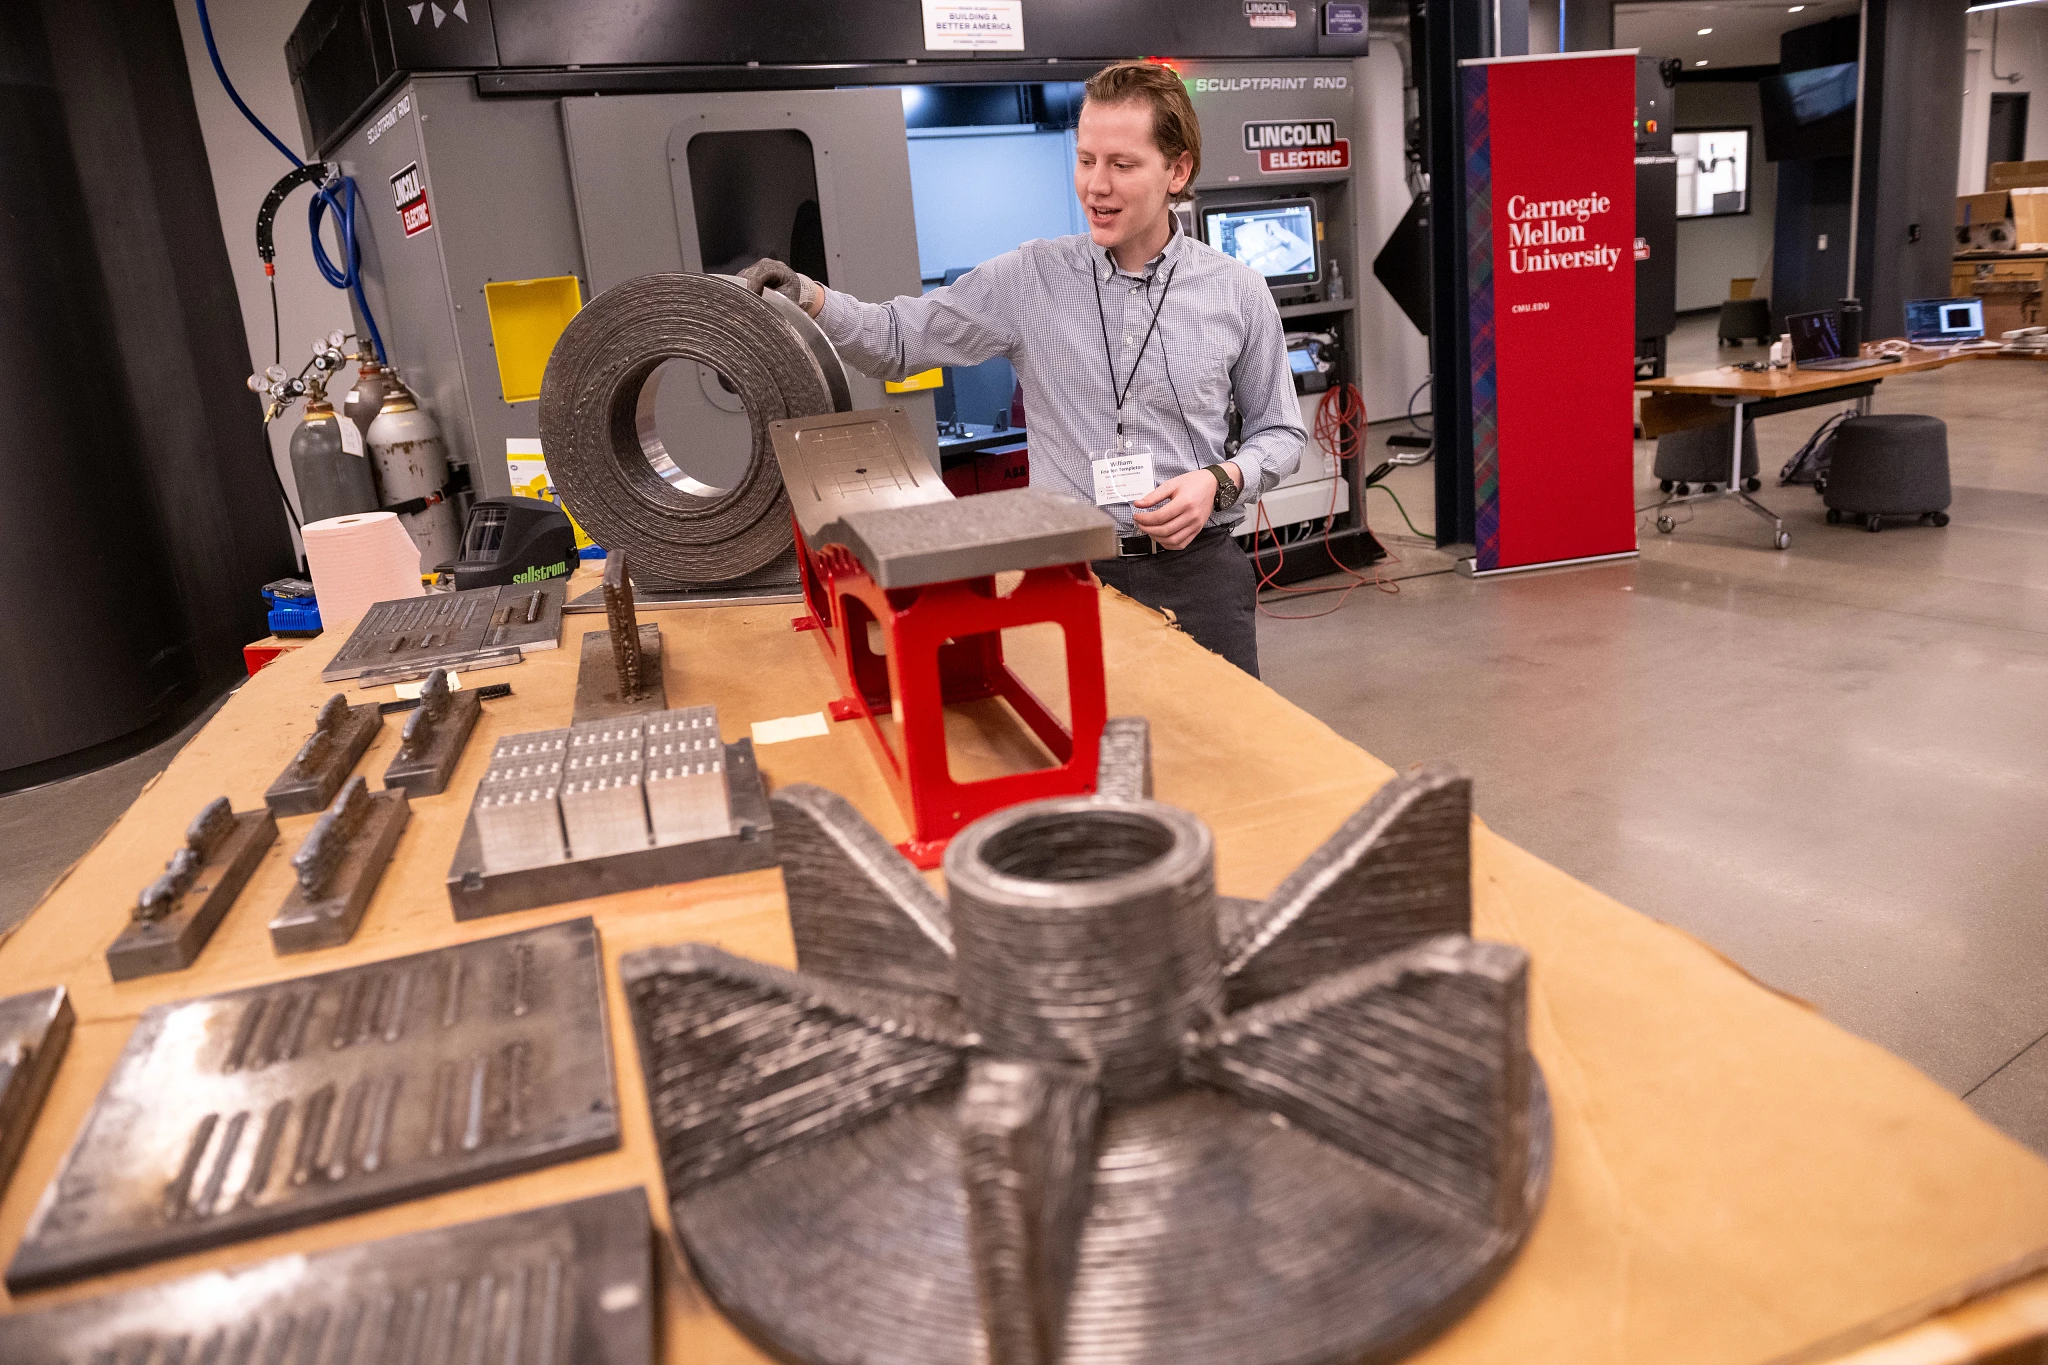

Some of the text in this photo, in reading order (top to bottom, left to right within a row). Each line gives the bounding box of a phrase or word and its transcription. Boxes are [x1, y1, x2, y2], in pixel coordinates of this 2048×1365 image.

[1245, 2, 1286, 14] LINCOLN
[1195, 76, 1347, 92] SCULPTPRINT RND
[367, 107, 397, 144] SCULPTPRINT
[1248, 125, 1331, 148] LINCOLN
[1269, 149, 1342, 169] ELECTRIC
[392, 169, 421, 203] LINCOLN
[404, 202, 429, 231] ELECTRIC
[1508, 191, 1610, 223] Carnegie
[1508, 219, 1586, 248] Mellon
[1508, 243, 1622, 274] University
[1511, 301, 1550, 314] CMU.EDU
[1004, 465, 1026, 480] ABB
[1109, 459, 1133, 467] William
[513, 561, 566, 584] sellstrom
